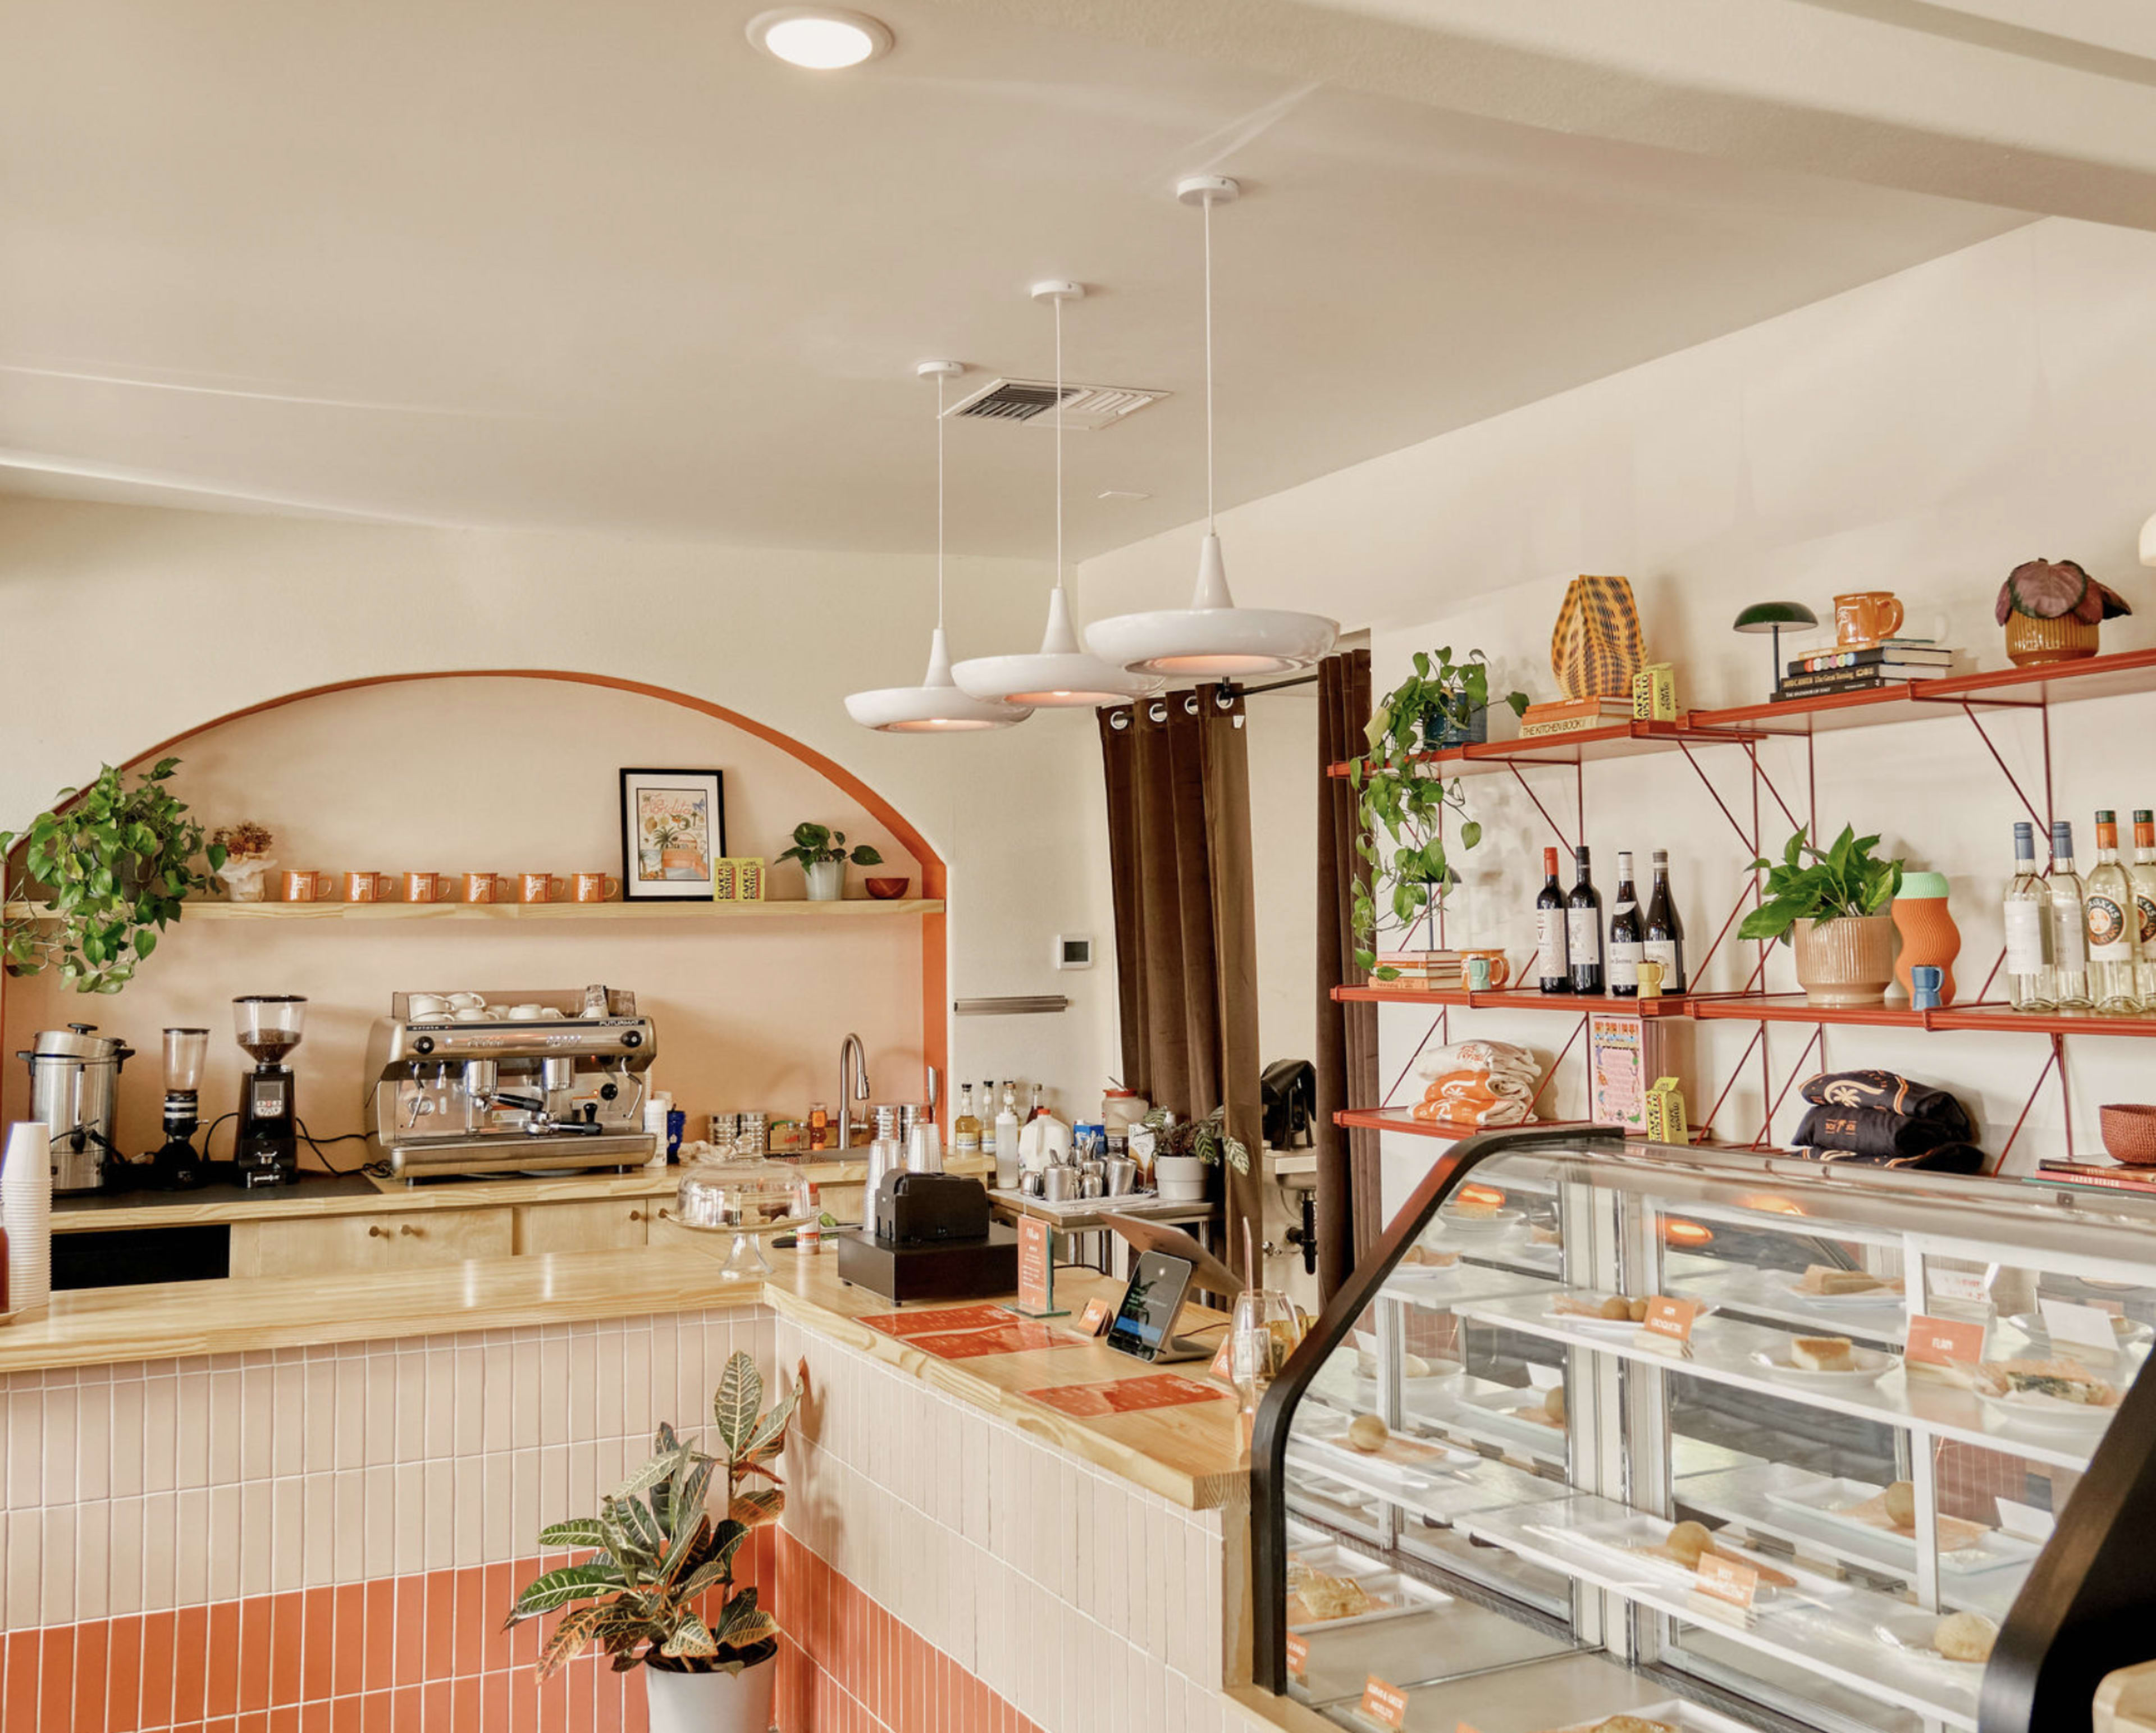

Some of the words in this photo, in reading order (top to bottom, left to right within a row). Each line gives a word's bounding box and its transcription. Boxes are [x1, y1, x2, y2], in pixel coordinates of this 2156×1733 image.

[1523, 726, 1535, 737] THE
[1536, 722, 1561, 735] KITCHEN
[1563, 719, 1581, 731] BOOK
